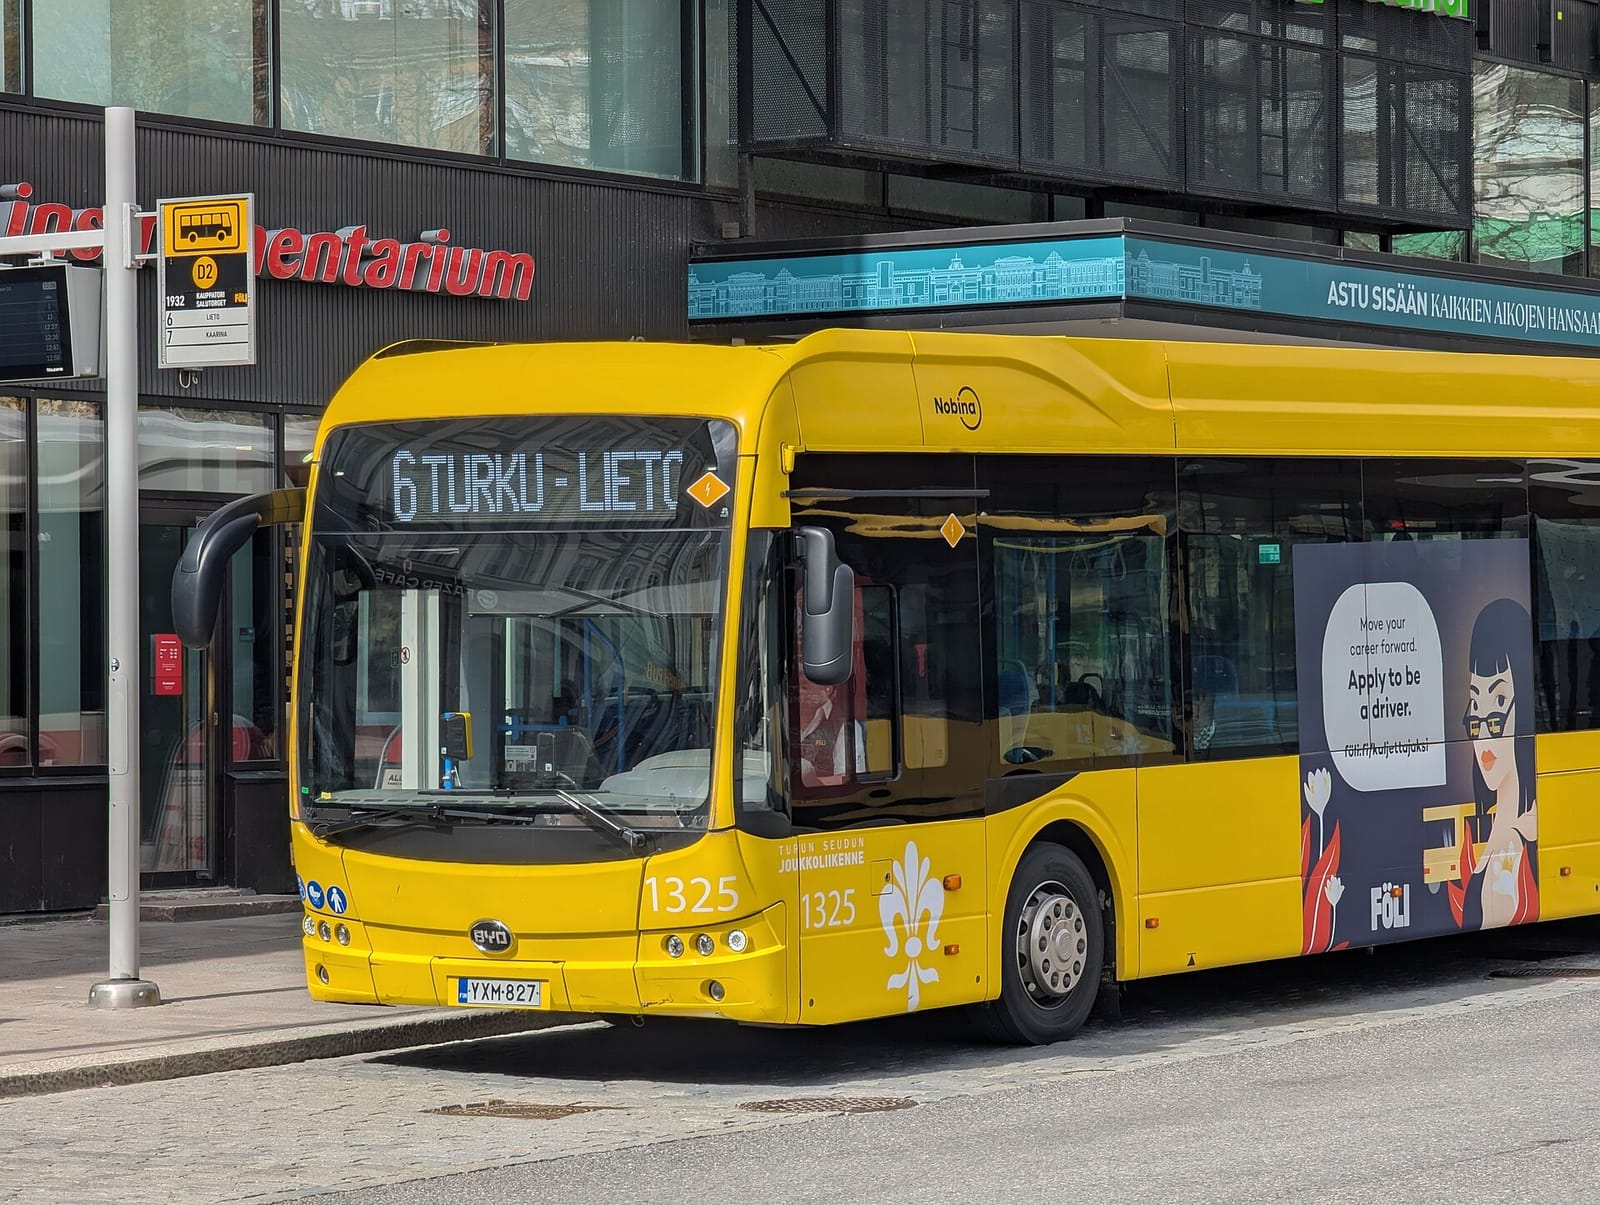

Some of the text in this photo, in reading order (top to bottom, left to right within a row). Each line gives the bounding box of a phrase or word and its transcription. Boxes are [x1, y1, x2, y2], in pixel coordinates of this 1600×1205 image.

[197, 263, 213, 280] D2
[166, 295, 185, 307] 1932
[1327, 280, 1600, 335] ASTU SISÄÄN KAIKKIEN AIKOJEN HANSAA
[167, 312, 220, 327] 6 LIETO
[167, 330, 173, 345] 7
[933, 396, 977, 415] Nobina
[392, 450, 418, 522] 6
[421, 453, 545, 513] TURKU
[1359, 616, 1406, 634] Move your
[1349, 637, 1418, 656] career forward.
[1348, 664, 1421, 696] Apply to be
[1360, 697, 1412, 720] a driver.
[778, 837, 865, 856] TURUN SEUDUN
[778, 851, 865, 873] JOUKKOLIIKENNE
[645, 875, 740, 913] 1325
[801, 888, 856, 929] 1325
[1370, 881, 1410, 931] FÖLI
[473, 929, 508, 945] BYD
